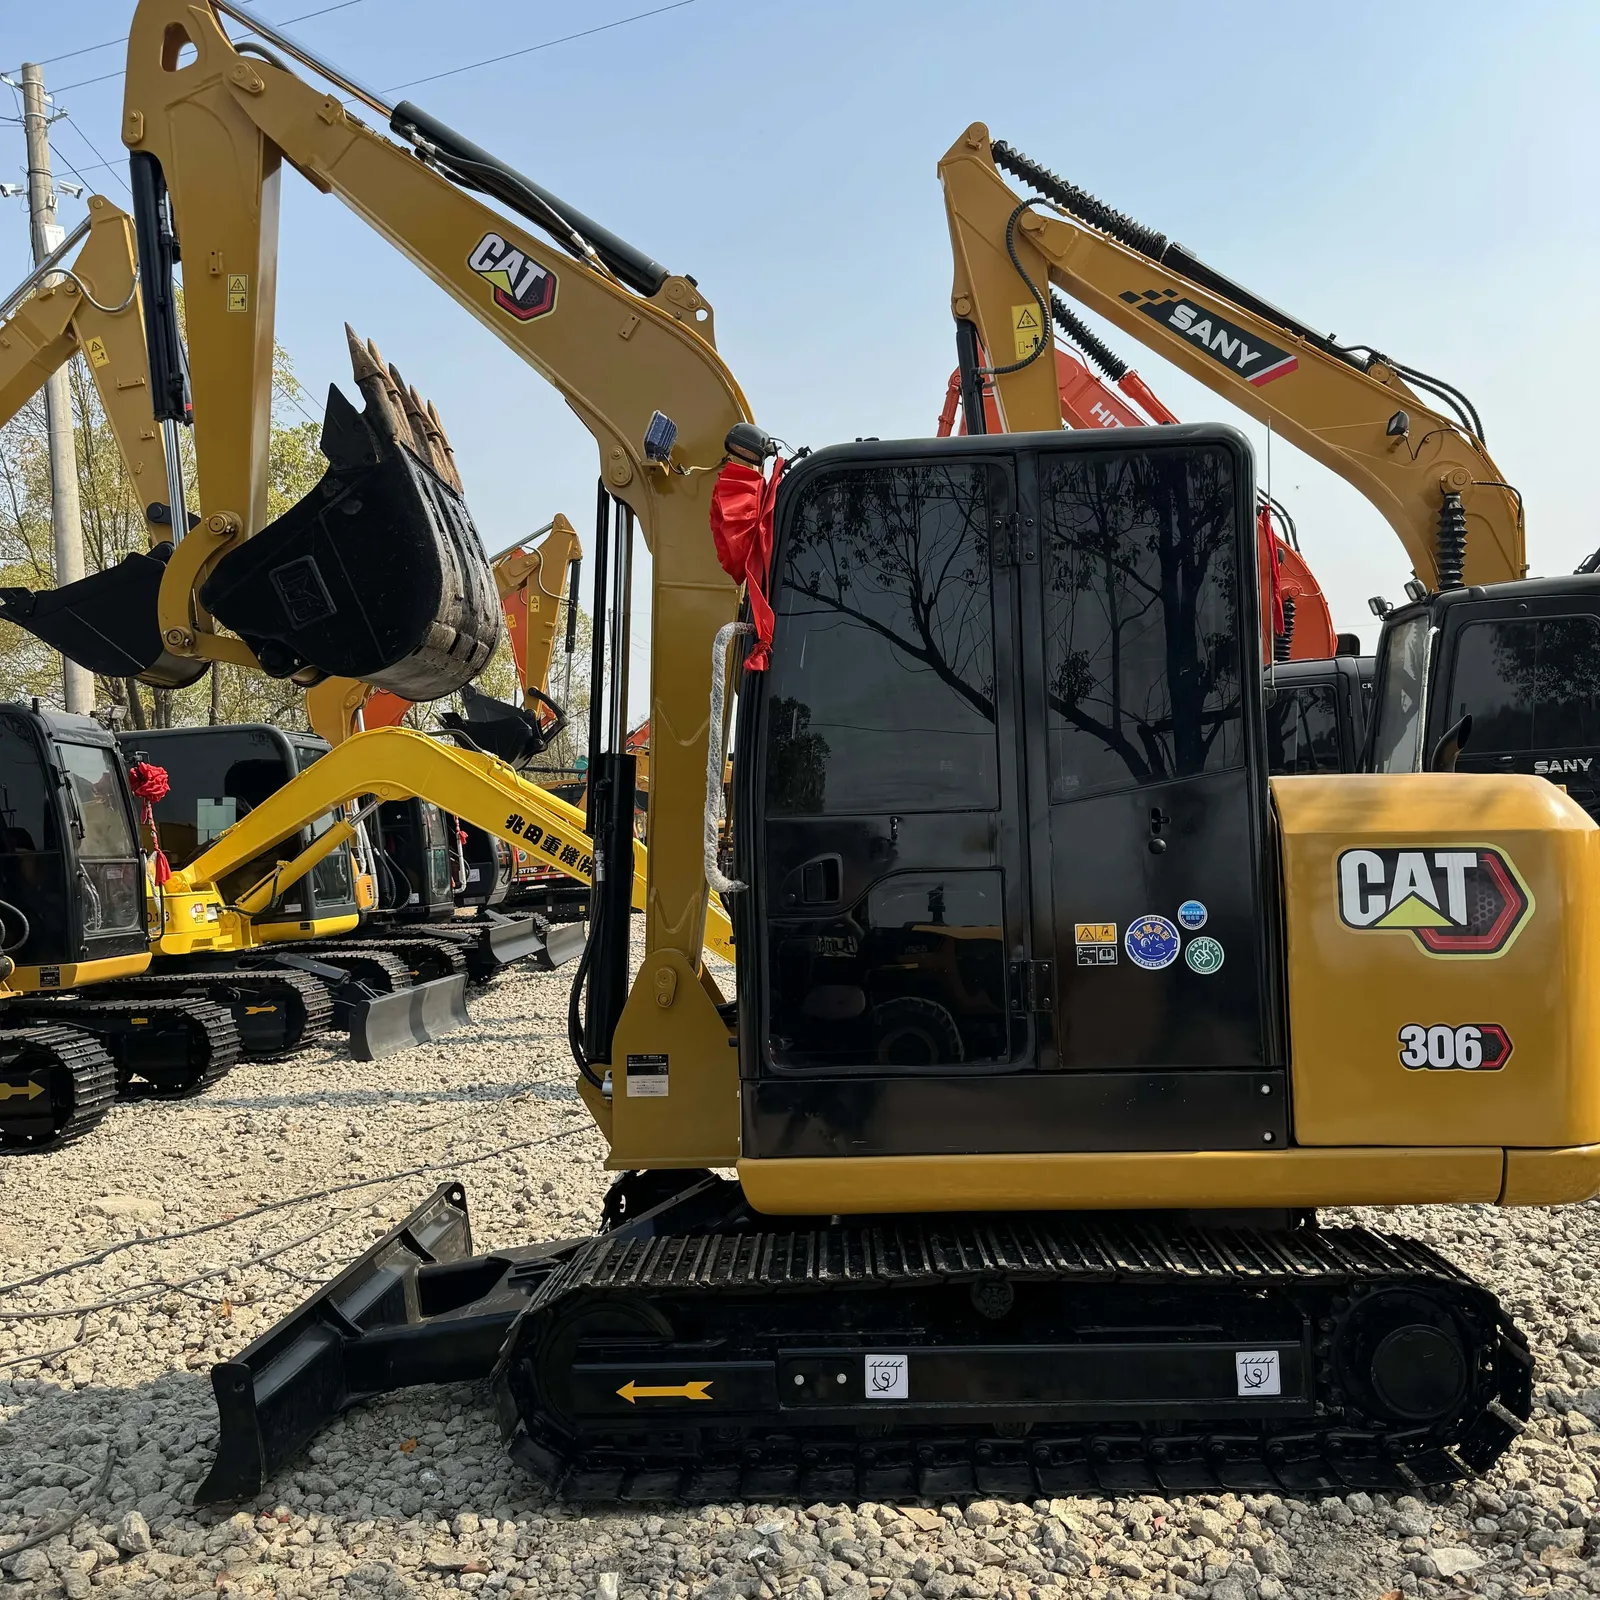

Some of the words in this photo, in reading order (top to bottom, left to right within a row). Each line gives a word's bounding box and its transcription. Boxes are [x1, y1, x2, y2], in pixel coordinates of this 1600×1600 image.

[469, 233, 547, 301] CAT
[1168, 304, 1262, 369] SANY
[1533, 757, 1594, 775] SANY
[1340, 850, 1478, 926] CAT
[1400, 1025, 1483, 1069] 306
